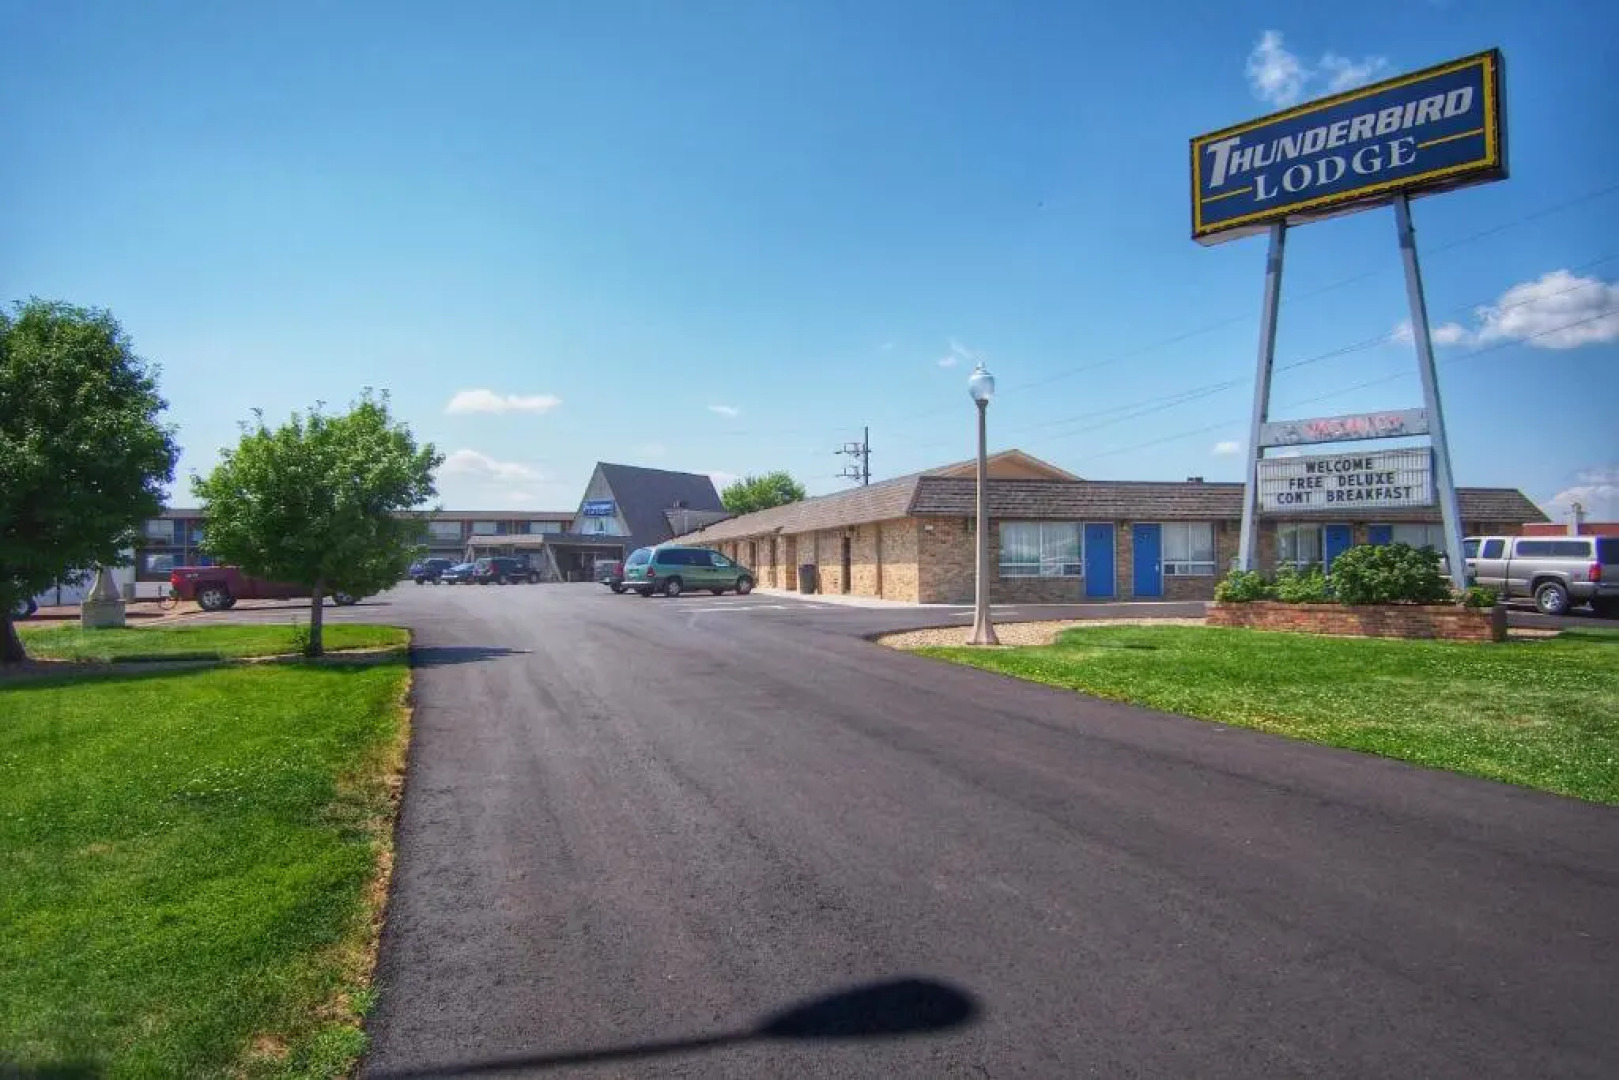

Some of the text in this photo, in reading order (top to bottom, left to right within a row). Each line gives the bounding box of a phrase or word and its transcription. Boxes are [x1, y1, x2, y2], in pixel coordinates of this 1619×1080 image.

[1206, 86, 1473, 189] THUNDERBIRD
[1254, 137, 1417, 201] LODGE
[1306, 458, 1372, 473] WELCOME
[1289, 472, 1394, 490] FREE DELUXE
[1277, 486, 1411, 504] CONT BREAKFAST
